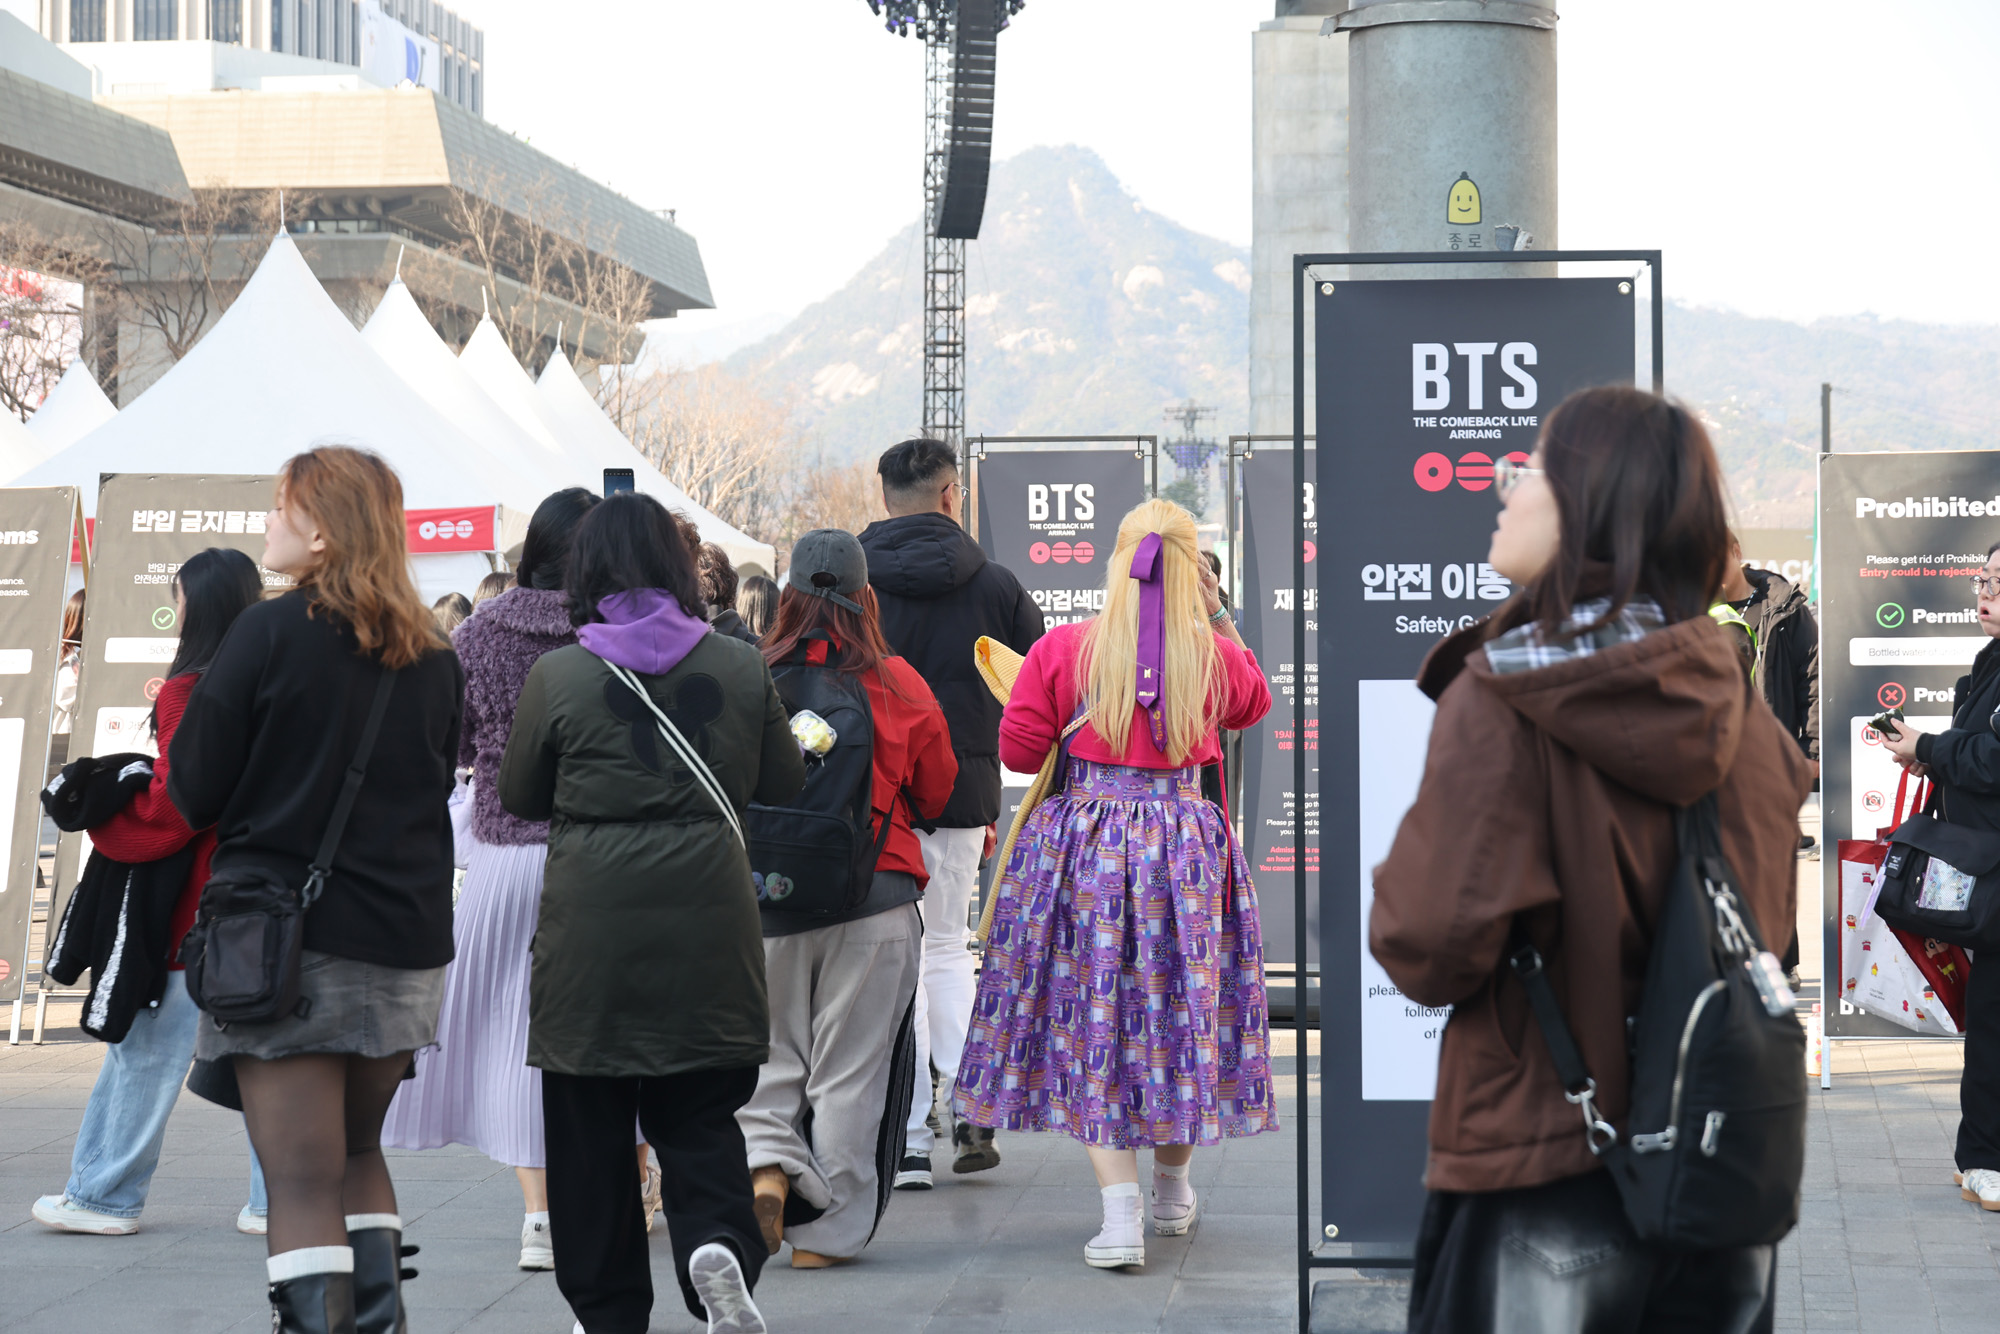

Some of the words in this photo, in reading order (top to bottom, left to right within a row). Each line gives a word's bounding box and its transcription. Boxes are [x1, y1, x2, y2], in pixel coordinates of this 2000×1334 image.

[1448, 232, 1482, 250] 종로
[1412, 341, 1538, 411] BTS
[1413, 417, 1437, 427] THE
[1439, 416, 1509, 427] COMEBACK
[1511, 416, 1538, 426] LIVE
[1449, 429, 1502, 439] ARIRANG
[1028, 483, 1095, 521] BTS
[1855, 496, 2000, 518] Prohibited
[132, 510, 176, 532] 반입
[1080, 522, 1095, 530] LIVE
[1866, 555, 1900, 565] Please
[1901, 556, 1917, 566] get
[1919, 555, 1932, 564] rid
[1934, 554, 1945, 564] of
[148, 563, 166, 573] 반입
[1860, 568, 1889, 579] Entry
[1891, 567, 1920, 577] could
[1923, 567, 1937, 576] be
[1939, 566, 1984, 578] rejected
[134, 574, 169, 585] 안전상의
[1361, 563, 1433, 601] 안전
[1441, 562, 1512, 601] 이동
[1912, 608, 1979, 624] Permit
[1395, 615, 1454, 637] Safety
[1868, 648, 1900, 657] Bottled
[1368, 984, 1403, 998] pleas
[1404, 1005, 1453, 1018] followi
[1423, 1028, 1437, 1039] of
